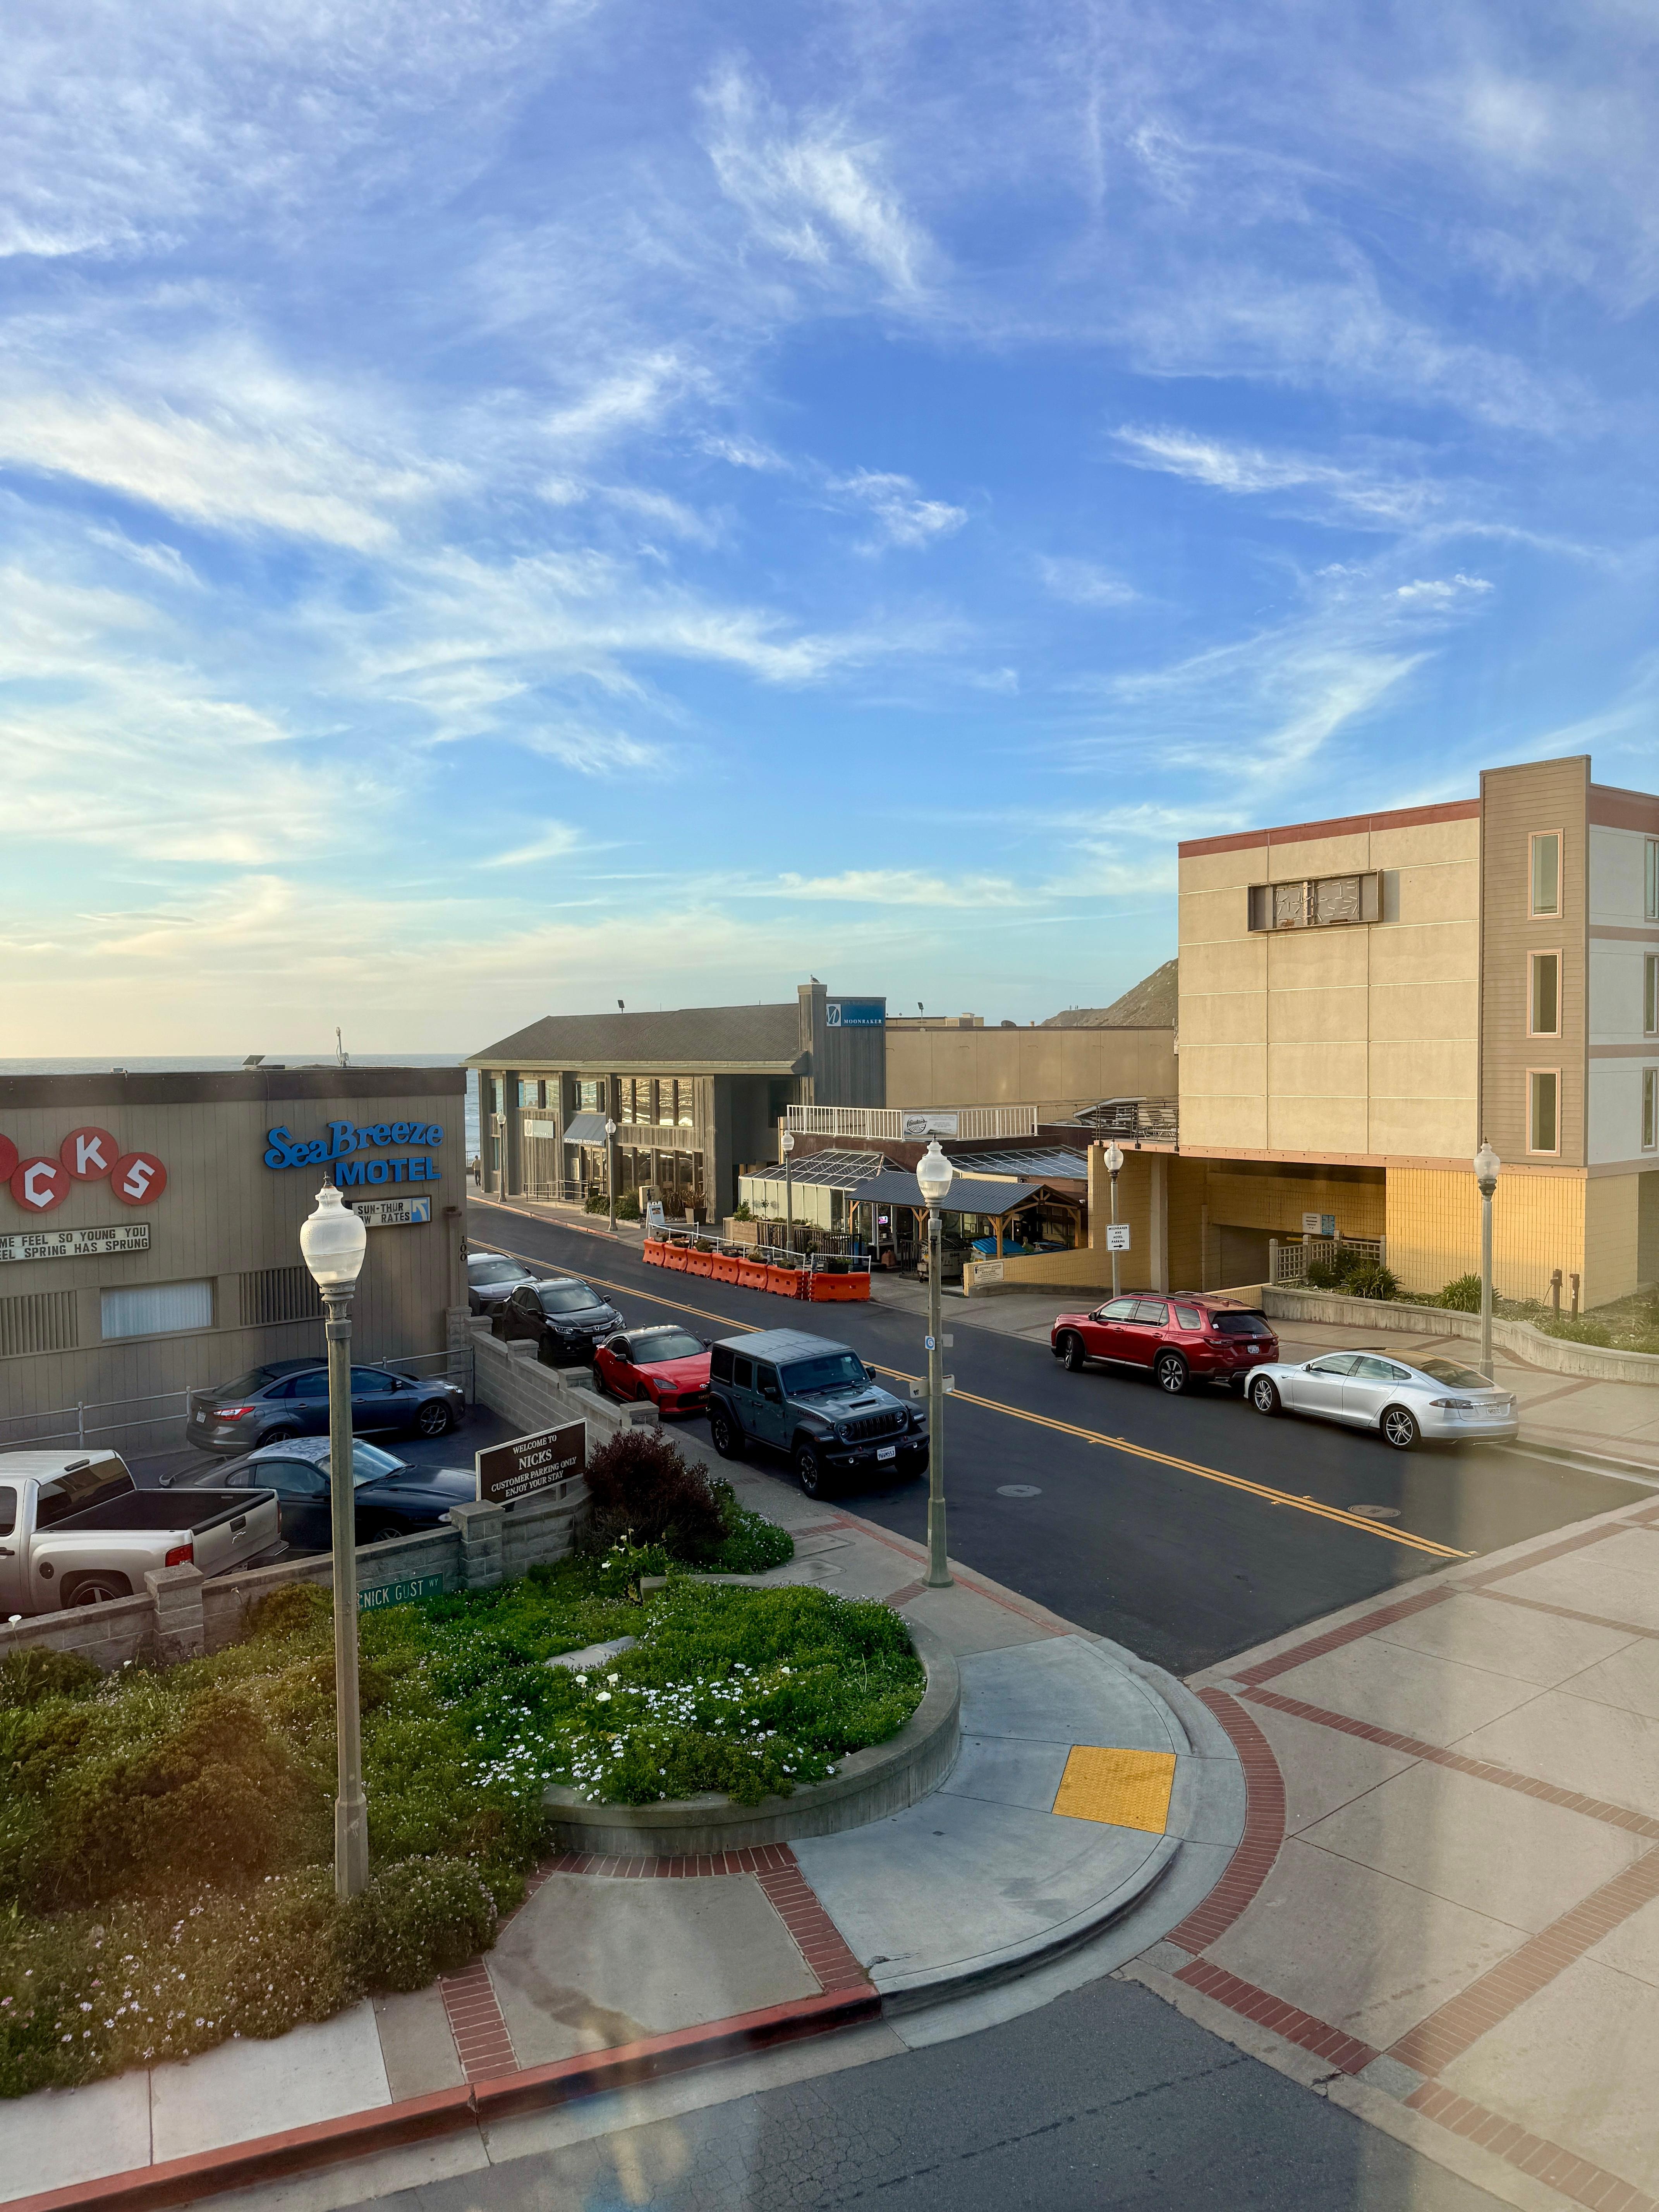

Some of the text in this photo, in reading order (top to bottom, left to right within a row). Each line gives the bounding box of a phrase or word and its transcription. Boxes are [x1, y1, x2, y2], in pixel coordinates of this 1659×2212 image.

[336, 1157, 442, 1186] MOTEL
[358, 1202, 403, 1214] SUN-THUR
[381, 1212, 410, 1223] RATES
[0, 1227, 146, 1249] ME FEEL SO YOUNG YOU
[0, 1238, 148, 1260] EL SPRING HAS SPRUNG
[513, 1434, 557, 1455] WELCOME TO
[519, 1449, 552, 1470] NICKS
[491, 1456, 577, 1492] CUSTOMER PARKING ONLY
[505, 1470, 564, 1498] ENJOY YOUR STAY
[364, 1578, 438, 1608] NICK GUST WY
